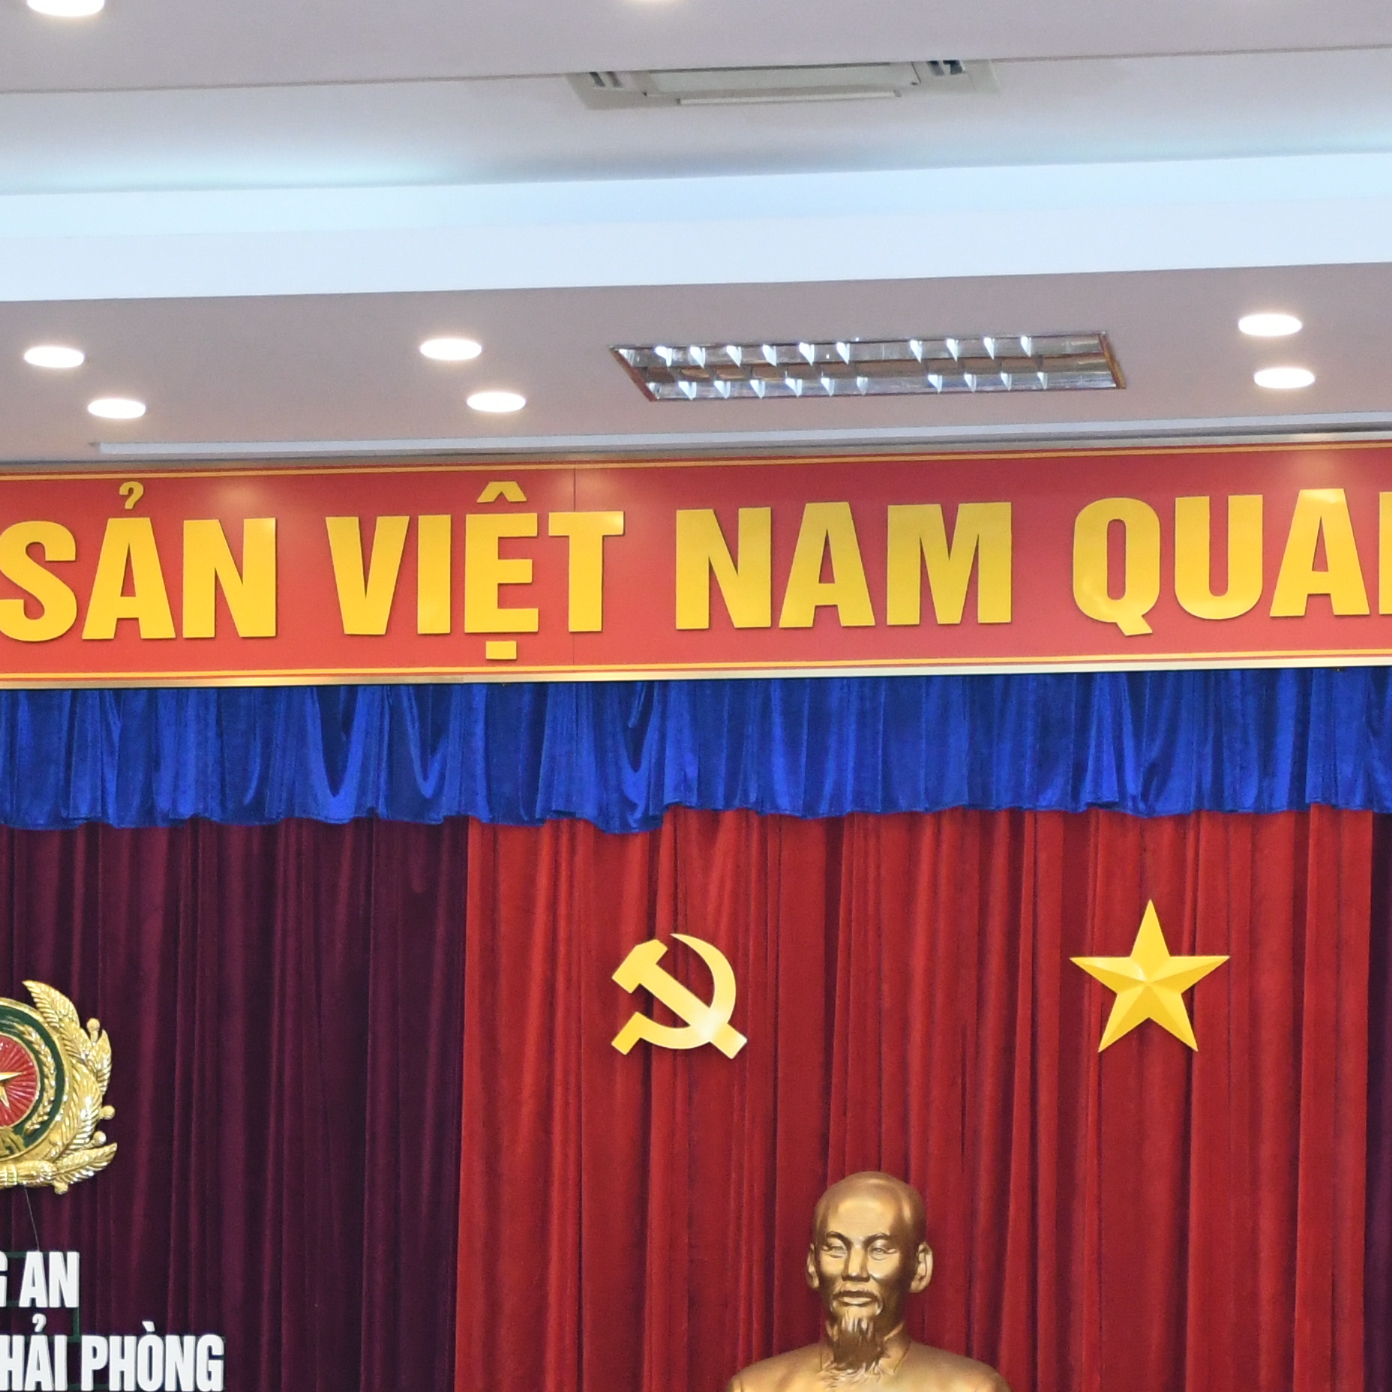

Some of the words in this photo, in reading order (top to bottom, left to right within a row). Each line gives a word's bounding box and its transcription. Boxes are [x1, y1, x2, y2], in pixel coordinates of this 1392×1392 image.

[326, 482, 624, 659] VIỆT
[676, 502, 1011, 629] NAM
[19, 1251, 79, 1307] AN
[81, 1321, 224, 1392] PHÒNG
